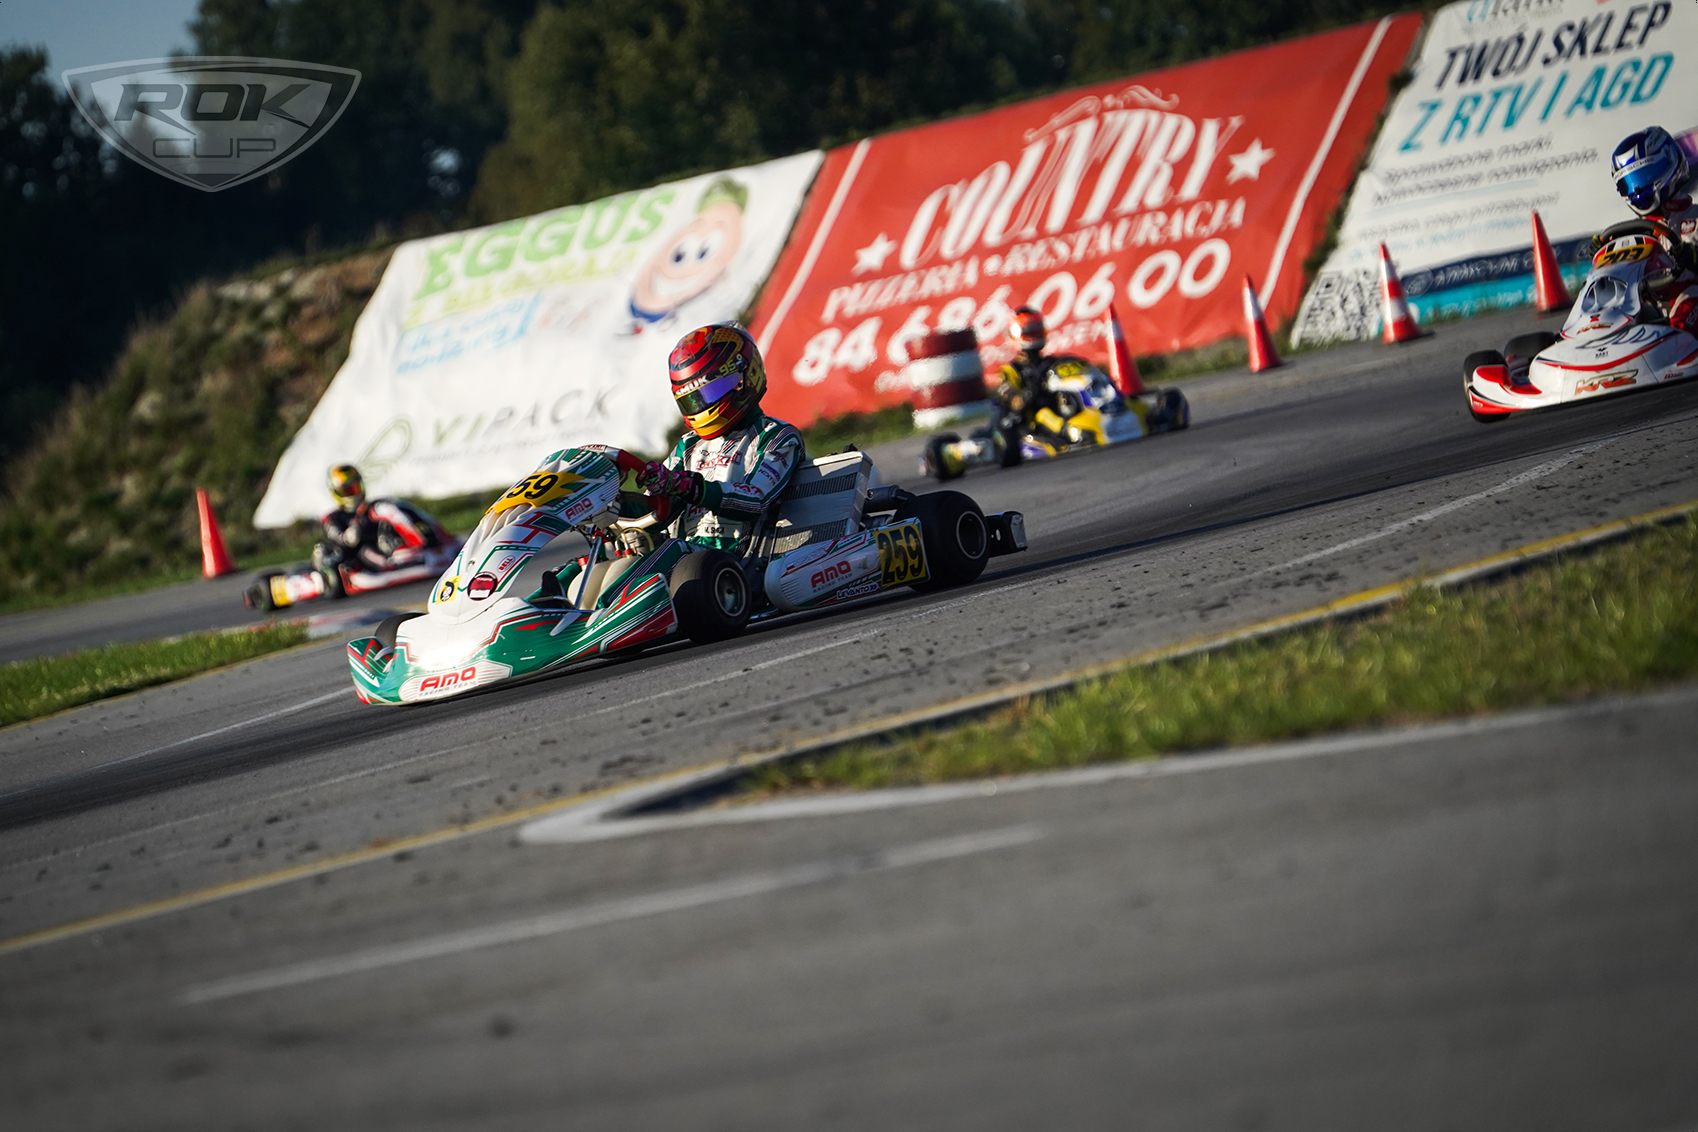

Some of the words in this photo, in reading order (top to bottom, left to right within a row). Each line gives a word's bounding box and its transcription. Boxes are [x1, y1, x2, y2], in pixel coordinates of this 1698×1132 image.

[1435, 21, 1545, 91] TWÓJ
[1541, 0, 1673, 68] SKLEP
[1397, 98, 1442, 153] Z
[1440, 75, 1545, 146] RTV
[1539, 69, 1571, 123] I
[1564, 51, 1675, 120] AGD
[899, 110, 1246, 270] COUNTRY
[414, 188, 676, 301] EGGUS
[792, 315, 883, 386] 84
[1027, 262, 1117, 331] 06
[1126, 238, 1232, 309] 00
[434, 383, 619, 446] VIPACK
[675, 375, 709, 397] SMUK
[500, 474, 559, 500] 59
[498, 556, 513, 570] BELL
[811, 560, 852, 589] AMO
[878, 525, 925, 584] 259
[837, 584, 870, 599] LEVANTO
[420, 666, 476, 691] AMO
